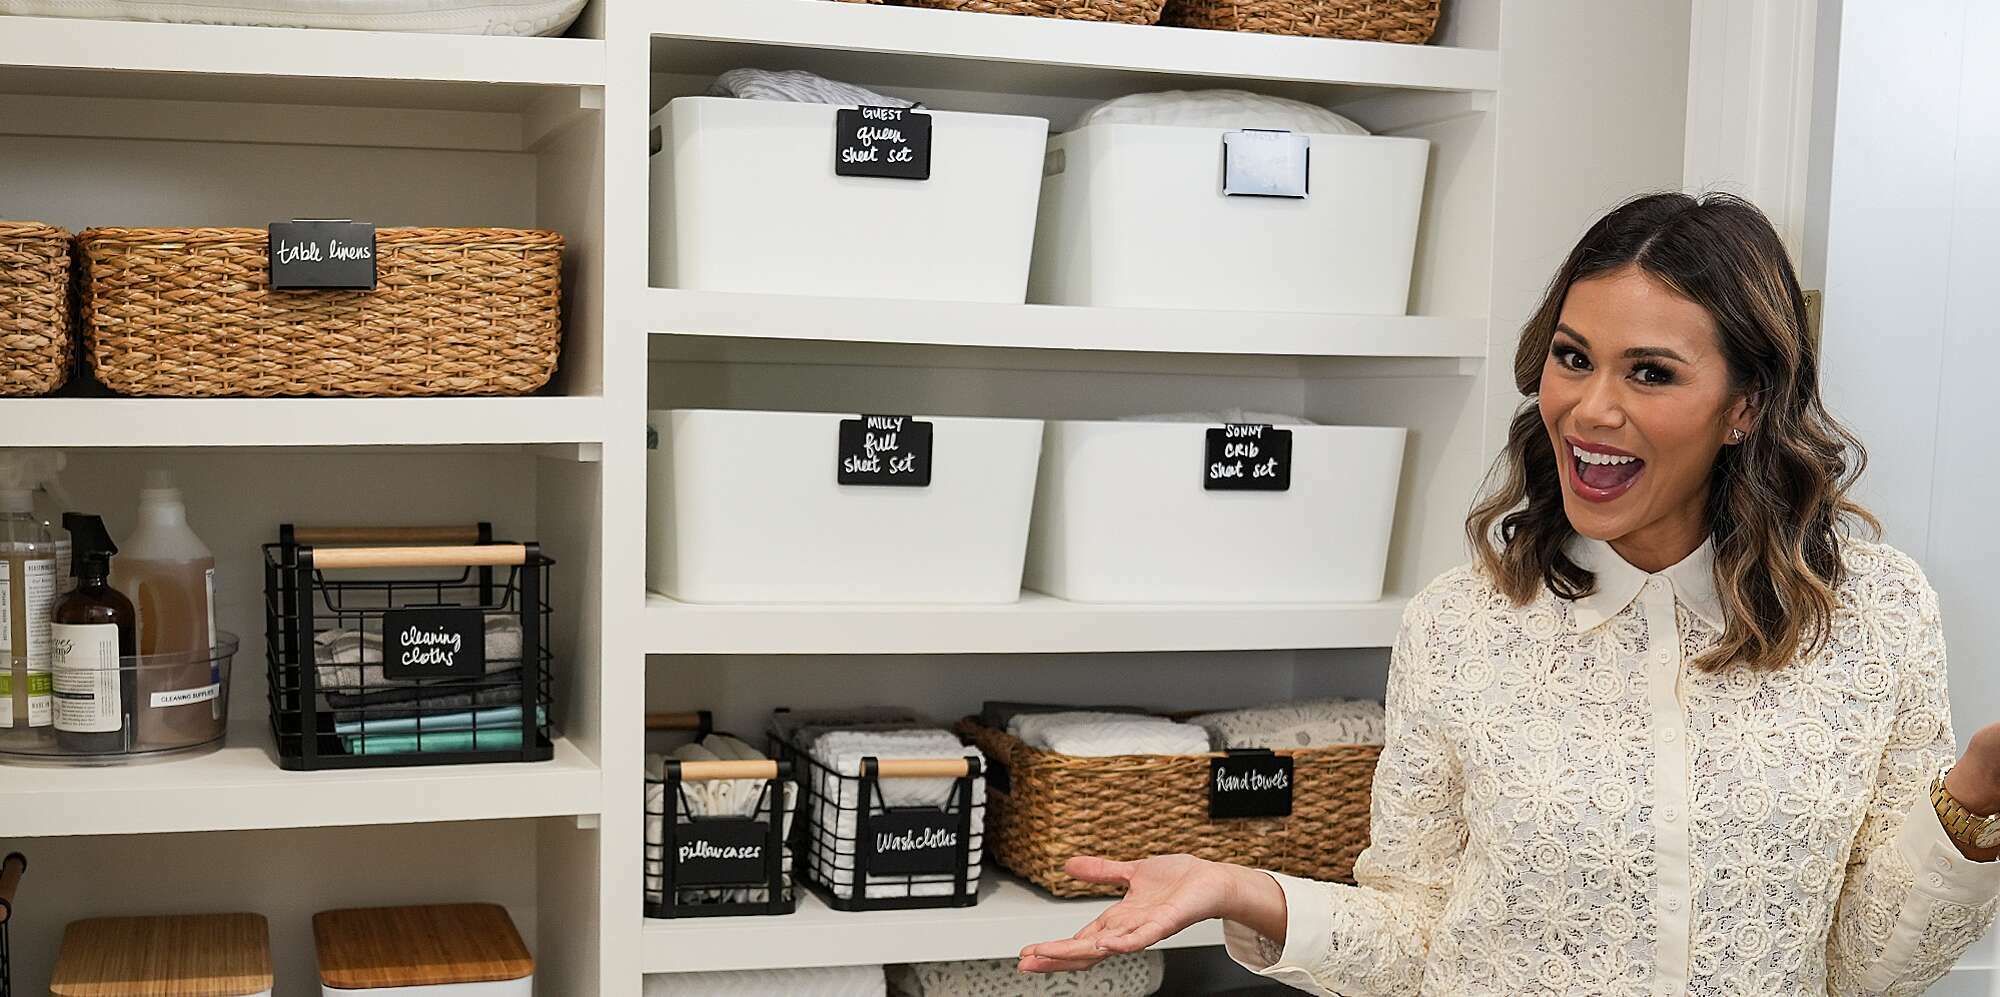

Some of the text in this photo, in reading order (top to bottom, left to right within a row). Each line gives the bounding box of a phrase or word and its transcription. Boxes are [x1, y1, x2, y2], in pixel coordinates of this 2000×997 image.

[862, 107, 903, 121] GUEST
[856, 126, 908, 147] queen
[842, 146, 913, 164] sheet set
[276, 239, 371, 264] table linens
[1225, 424, 1264, 439] SONNY
[863, 432, 899, 459] full
[844, 452, 916, 474] sheet set
[1252, 457, 1279, 478] set
[400, 625, 461, 653] cleaning
[401, 646, 454, 667] cloths
[679, 840, 762, 864] pillowcases
